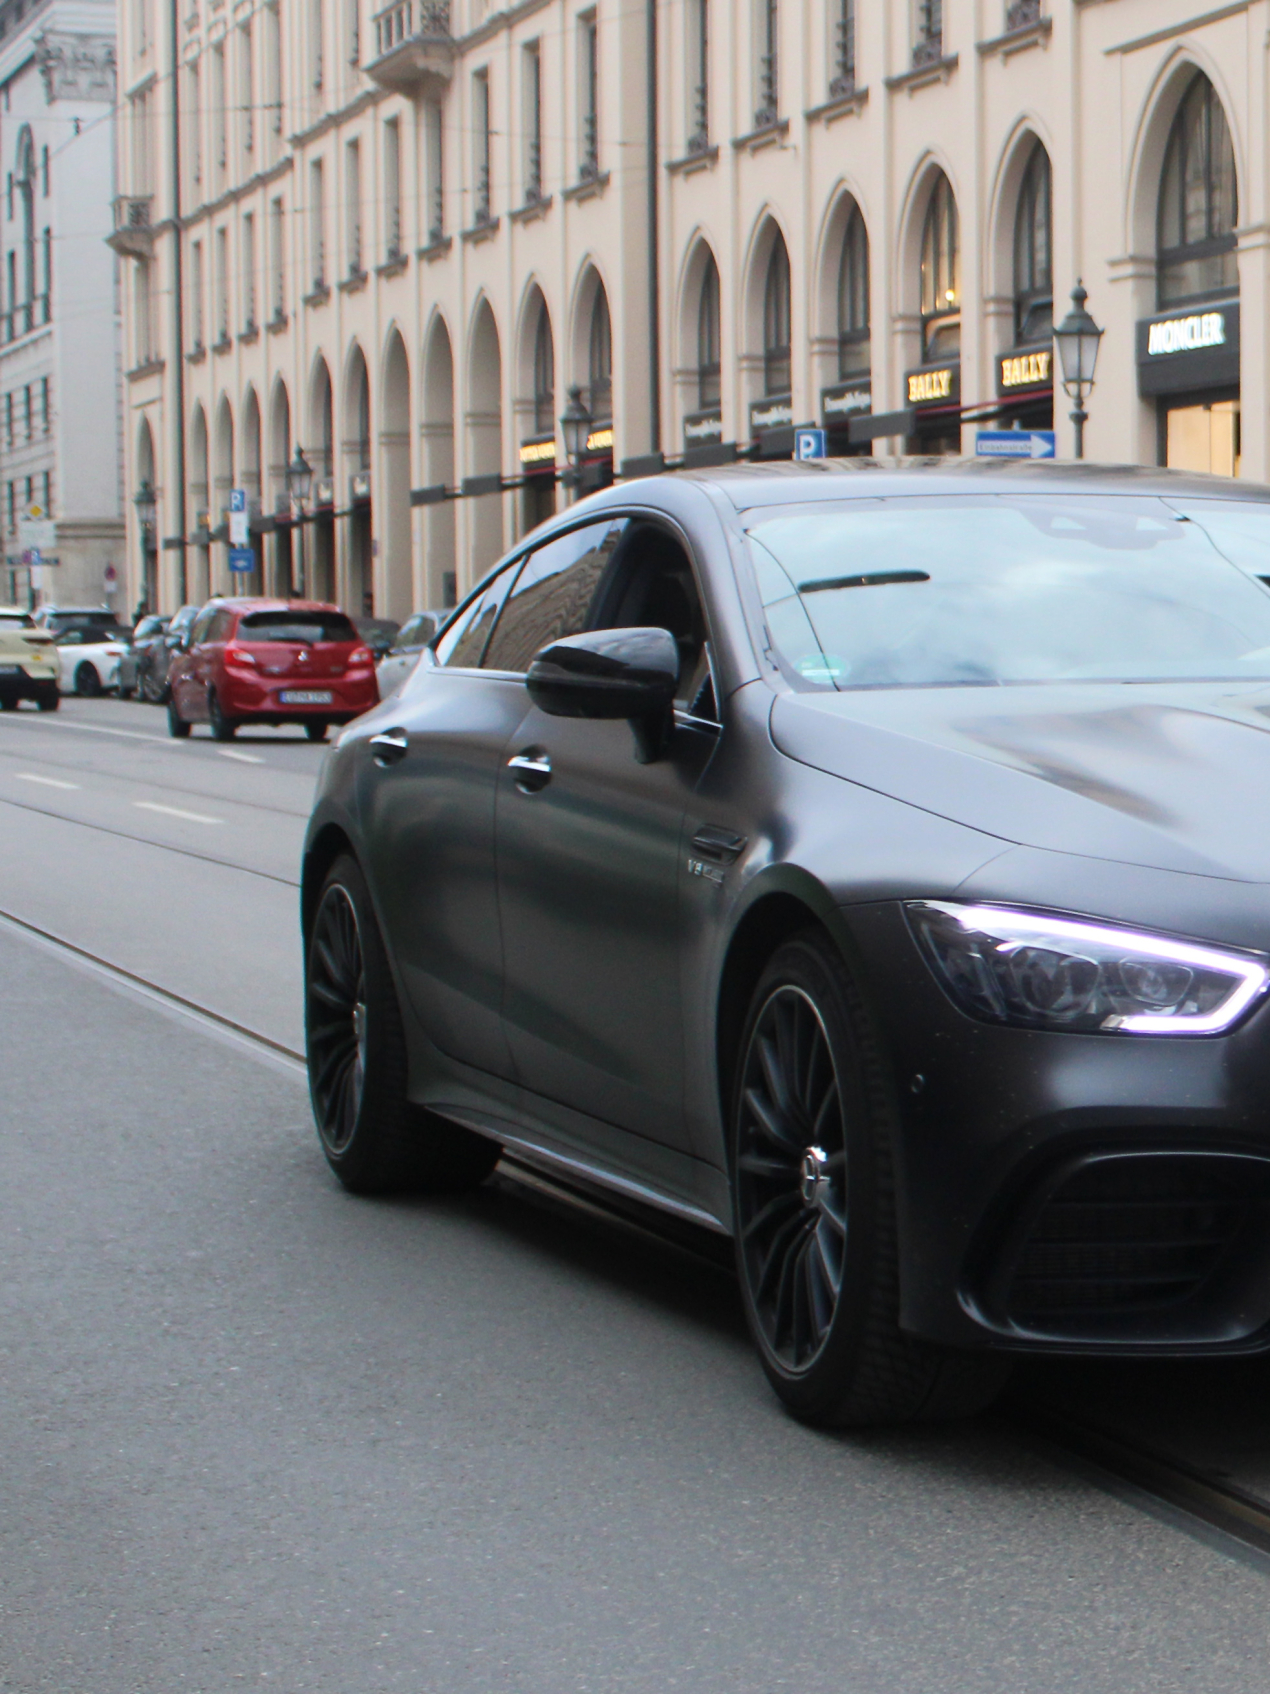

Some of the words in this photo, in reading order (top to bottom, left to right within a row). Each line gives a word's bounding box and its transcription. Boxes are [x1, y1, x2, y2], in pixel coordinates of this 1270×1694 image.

[1148, 312, 1227, 355] MONCLER
[908, 369, 951, 402] BALLY
[1001, 351, 1050, 388] BALLY
[800, 434, 815, 459] P
